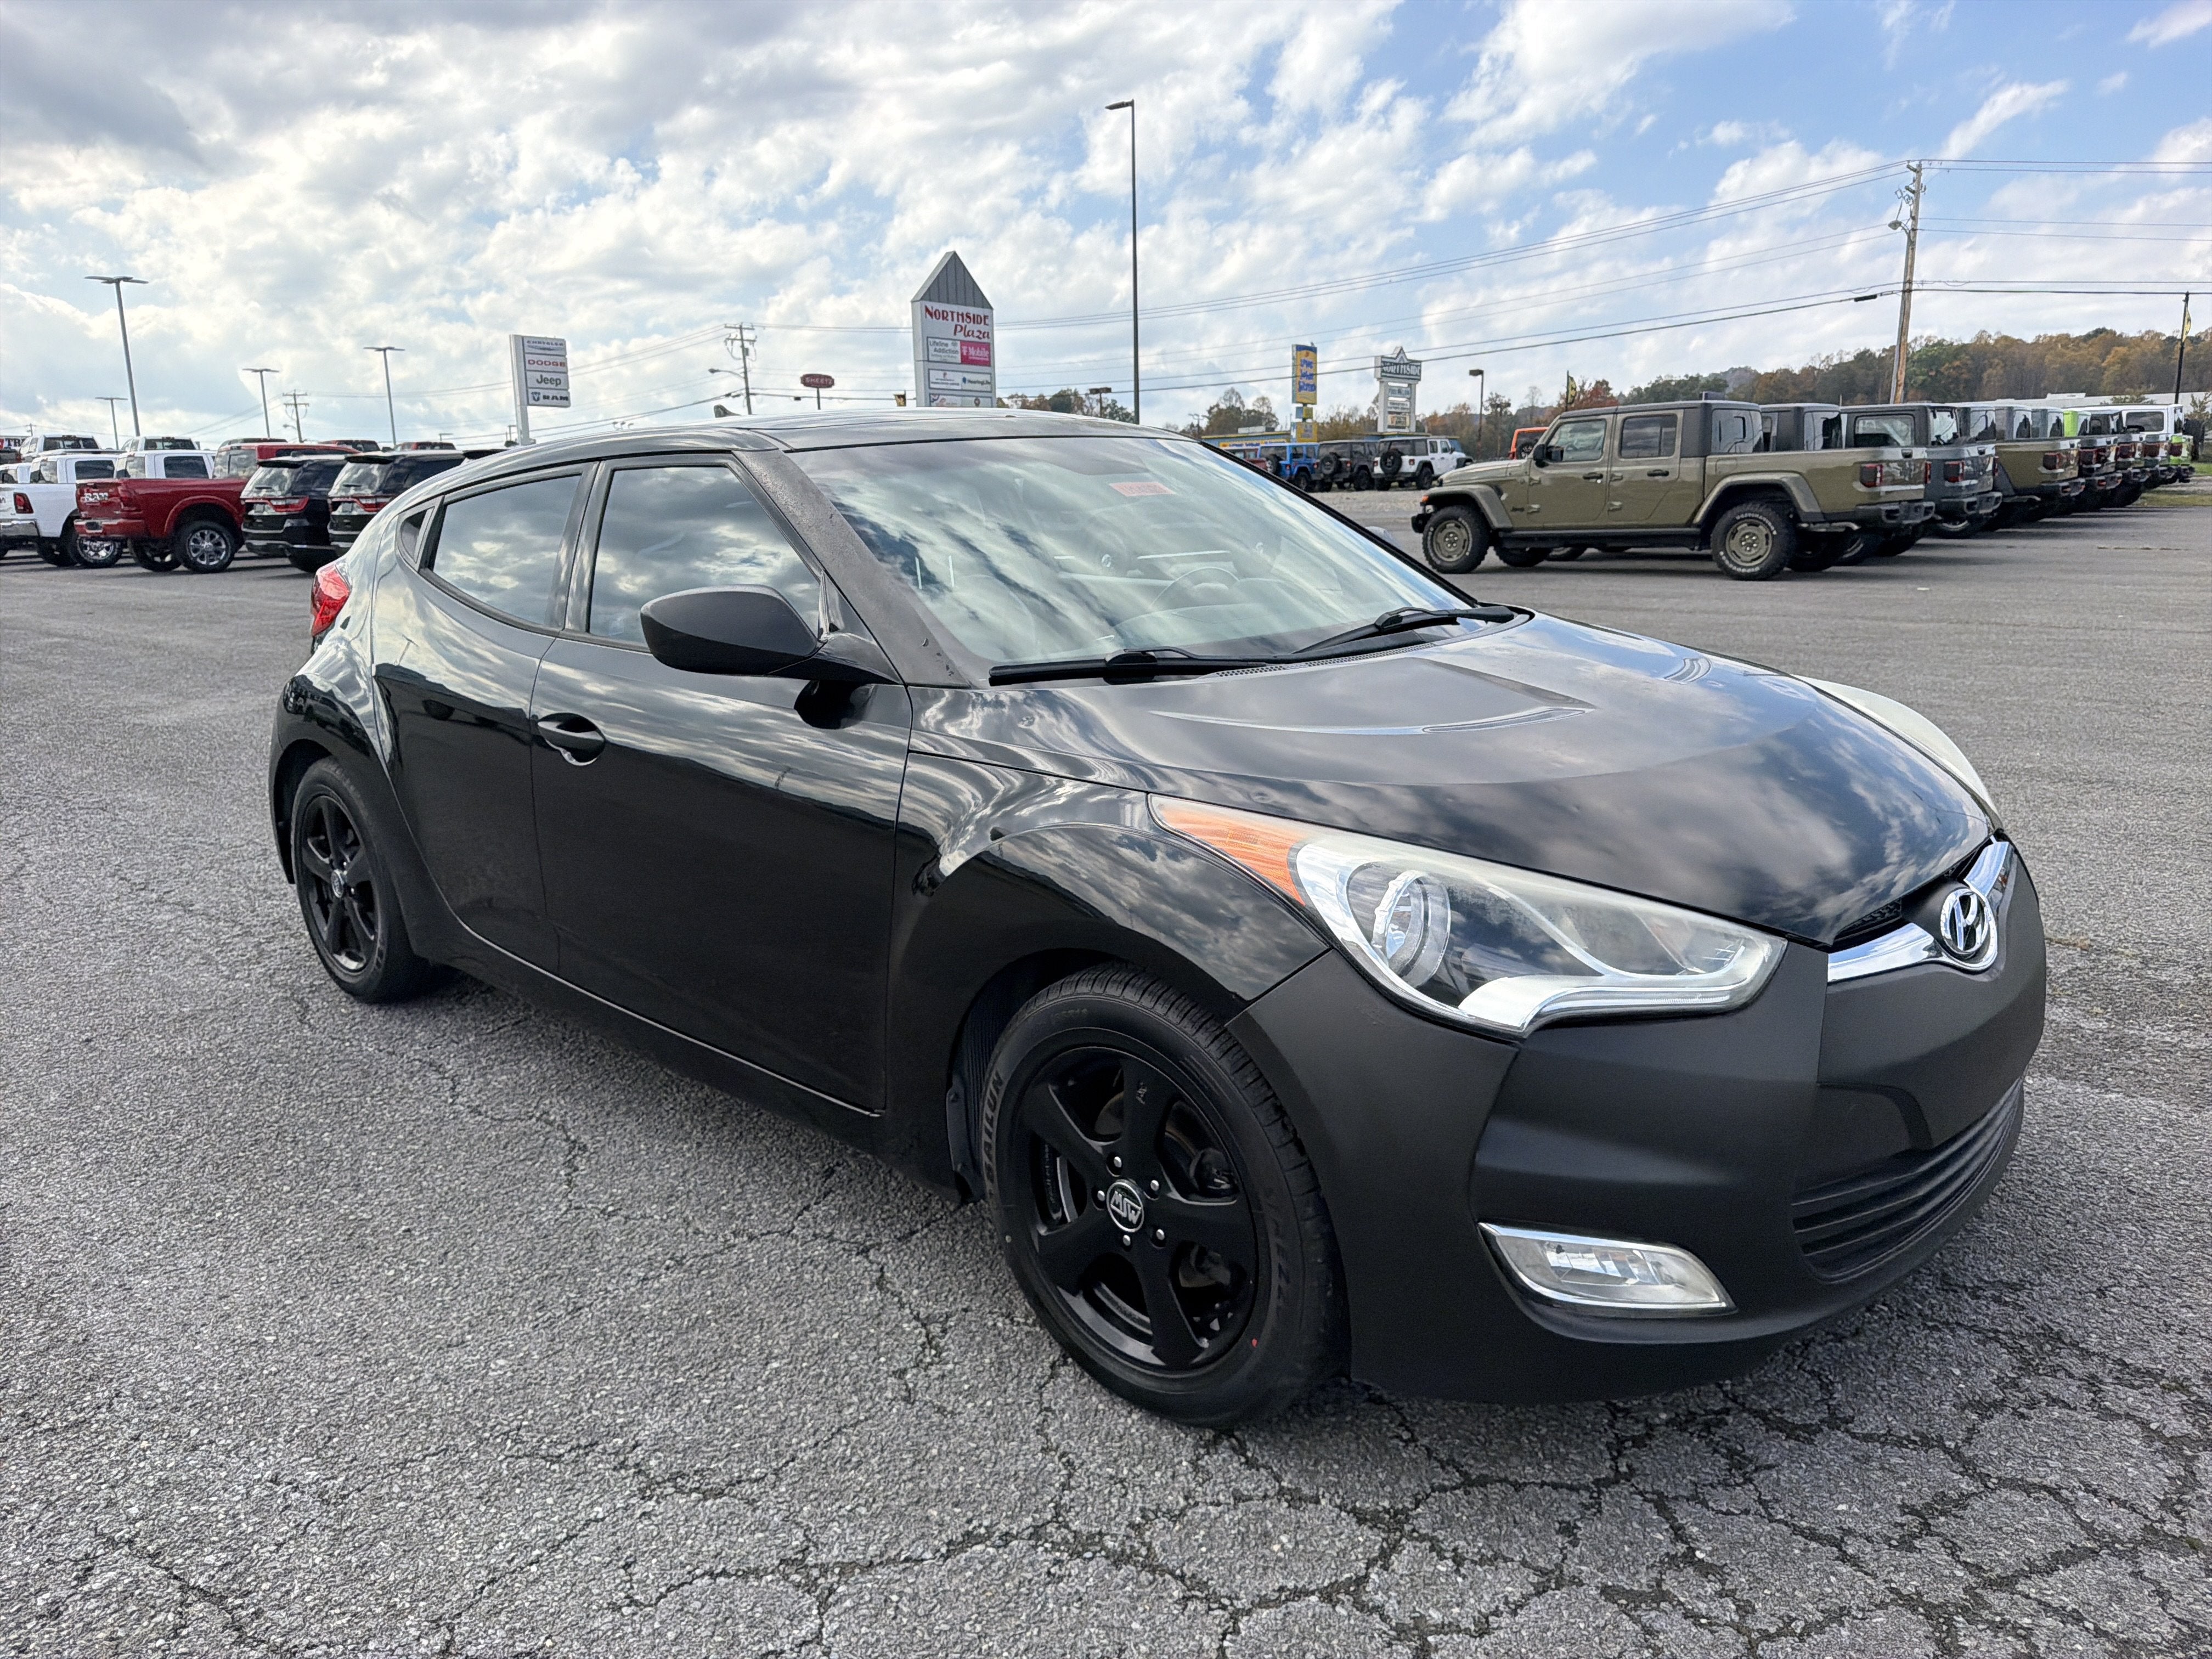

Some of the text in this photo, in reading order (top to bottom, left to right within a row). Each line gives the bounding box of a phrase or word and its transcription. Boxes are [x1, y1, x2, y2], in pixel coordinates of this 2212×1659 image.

[925, 305, 989, 326] NORTHSIDE
[953, 324, 990, 340] Plaza
[528, 359, 566, 368] DODGE
[537, 374, 562, 387] Jeep
[983, 1069, 1003, 1184] SAILUN
[1110, 1190, 1142, 1225] MSW
